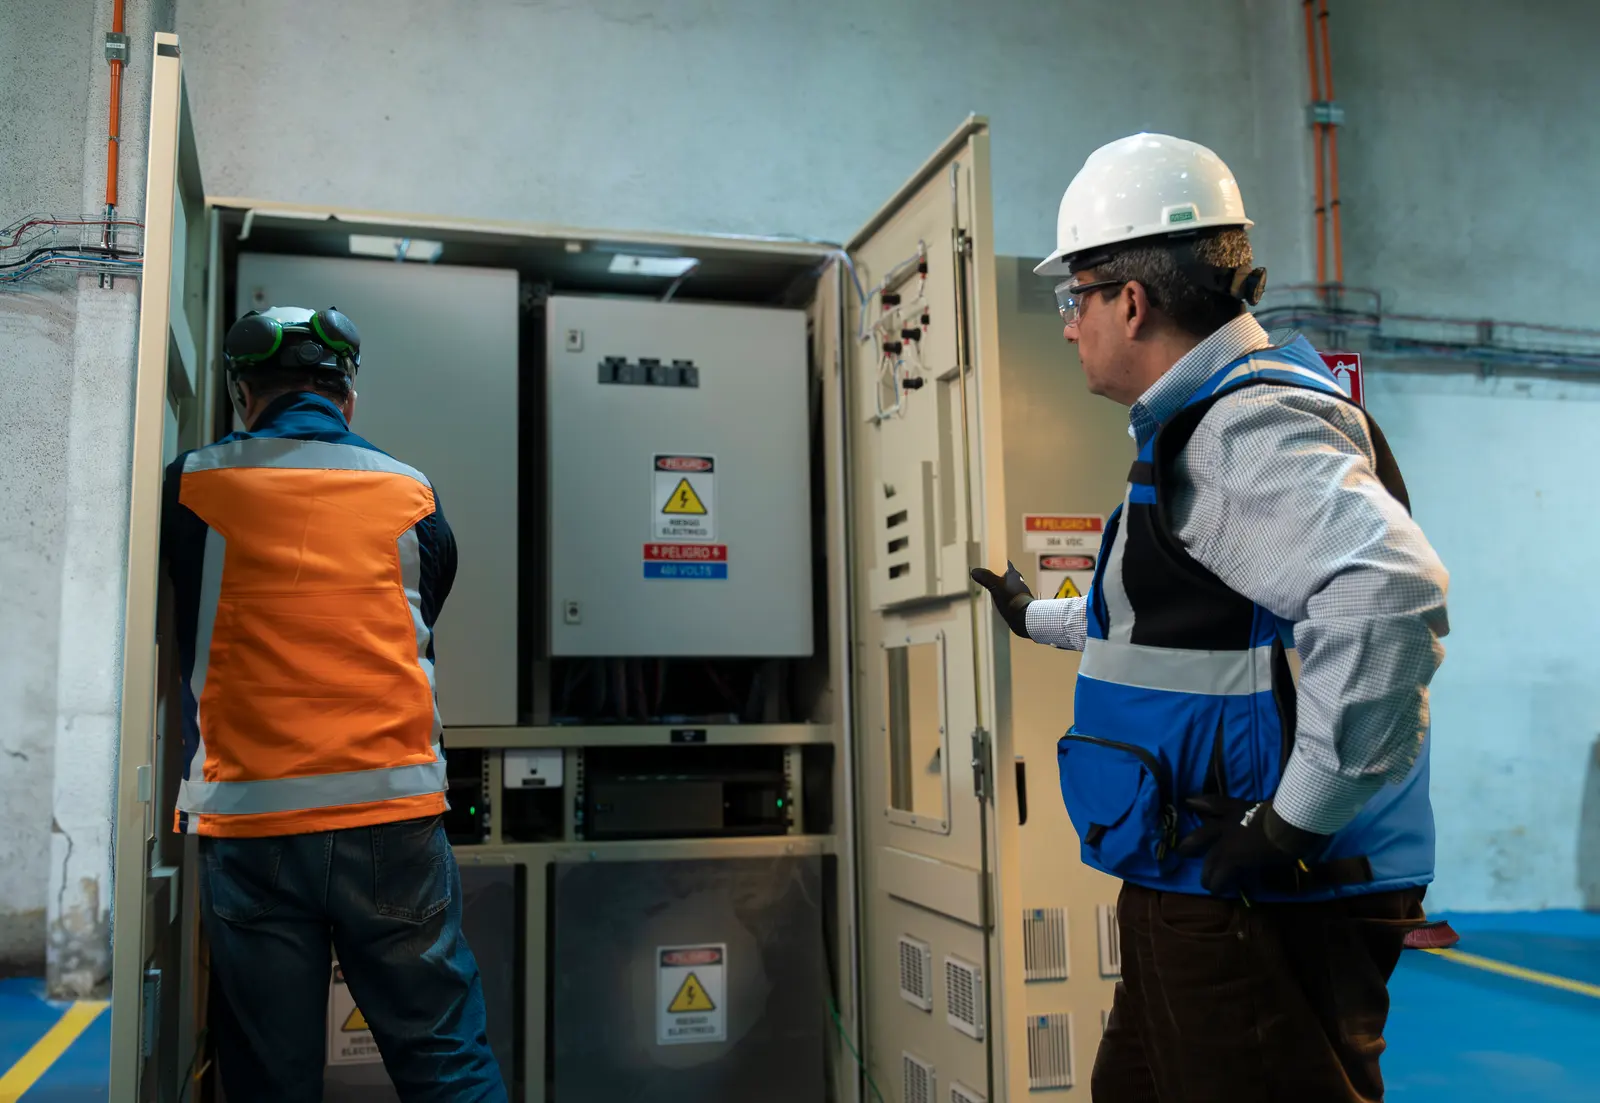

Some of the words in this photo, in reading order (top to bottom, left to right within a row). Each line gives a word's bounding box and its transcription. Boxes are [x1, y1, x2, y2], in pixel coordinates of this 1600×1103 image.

[1170, 212, 1192, 222] MSA
[1042, 518, 1086, 530] PELIGRO
[661, 546, 711, 559] PELIGRO
[680, 566, 712, 577] VOLTS
